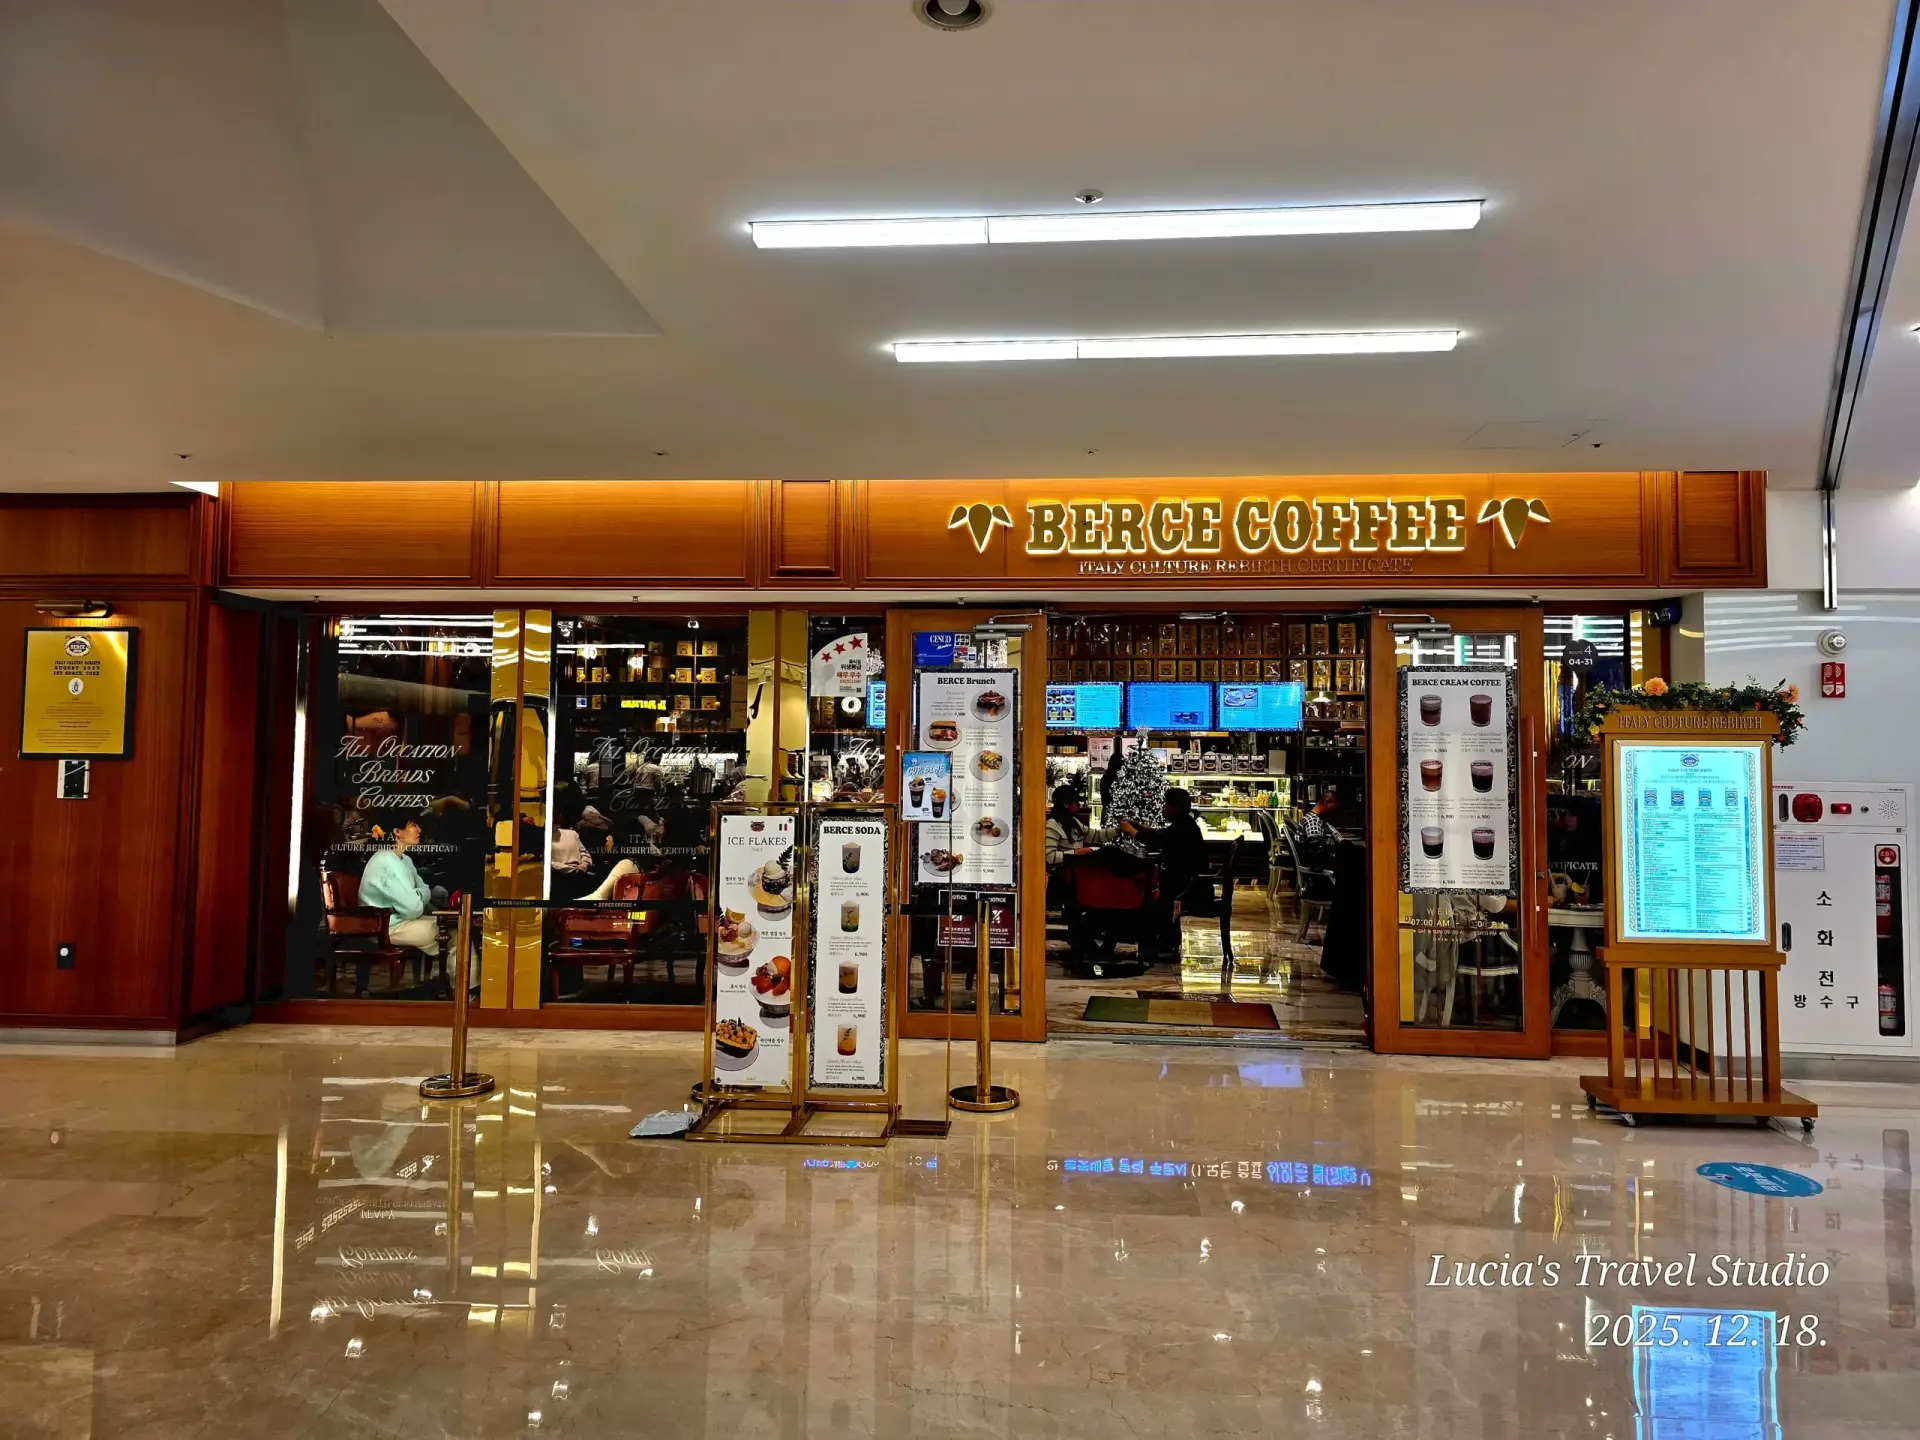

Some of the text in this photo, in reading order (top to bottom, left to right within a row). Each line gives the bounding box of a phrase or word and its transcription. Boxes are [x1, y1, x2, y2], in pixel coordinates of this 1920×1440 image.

[1026, 495, 1466, 554] BERCE COFFEE
[1078, 557, 1414, 575] ITALY CULTURE REBIRTH CERTIFICATE
[929, 634, 952, 644] CESCO
[1584, 645, 1593, 655] 4
[1568, 658, 1593, 666] 04-31
[840, 663, 862, 671] 위생등급
[937, 677, 996, 685] BERCE Brunch
[1618, 715, 1763, 730] ITALY CULTURE REBIRTH
[823, 825, 881, 835] BERCE SODA
[727, 837, 787, 846] ICE FLAKES
[331, 843, 365, 852] ULTURE
[1436, 919, 1450, 927] AM
